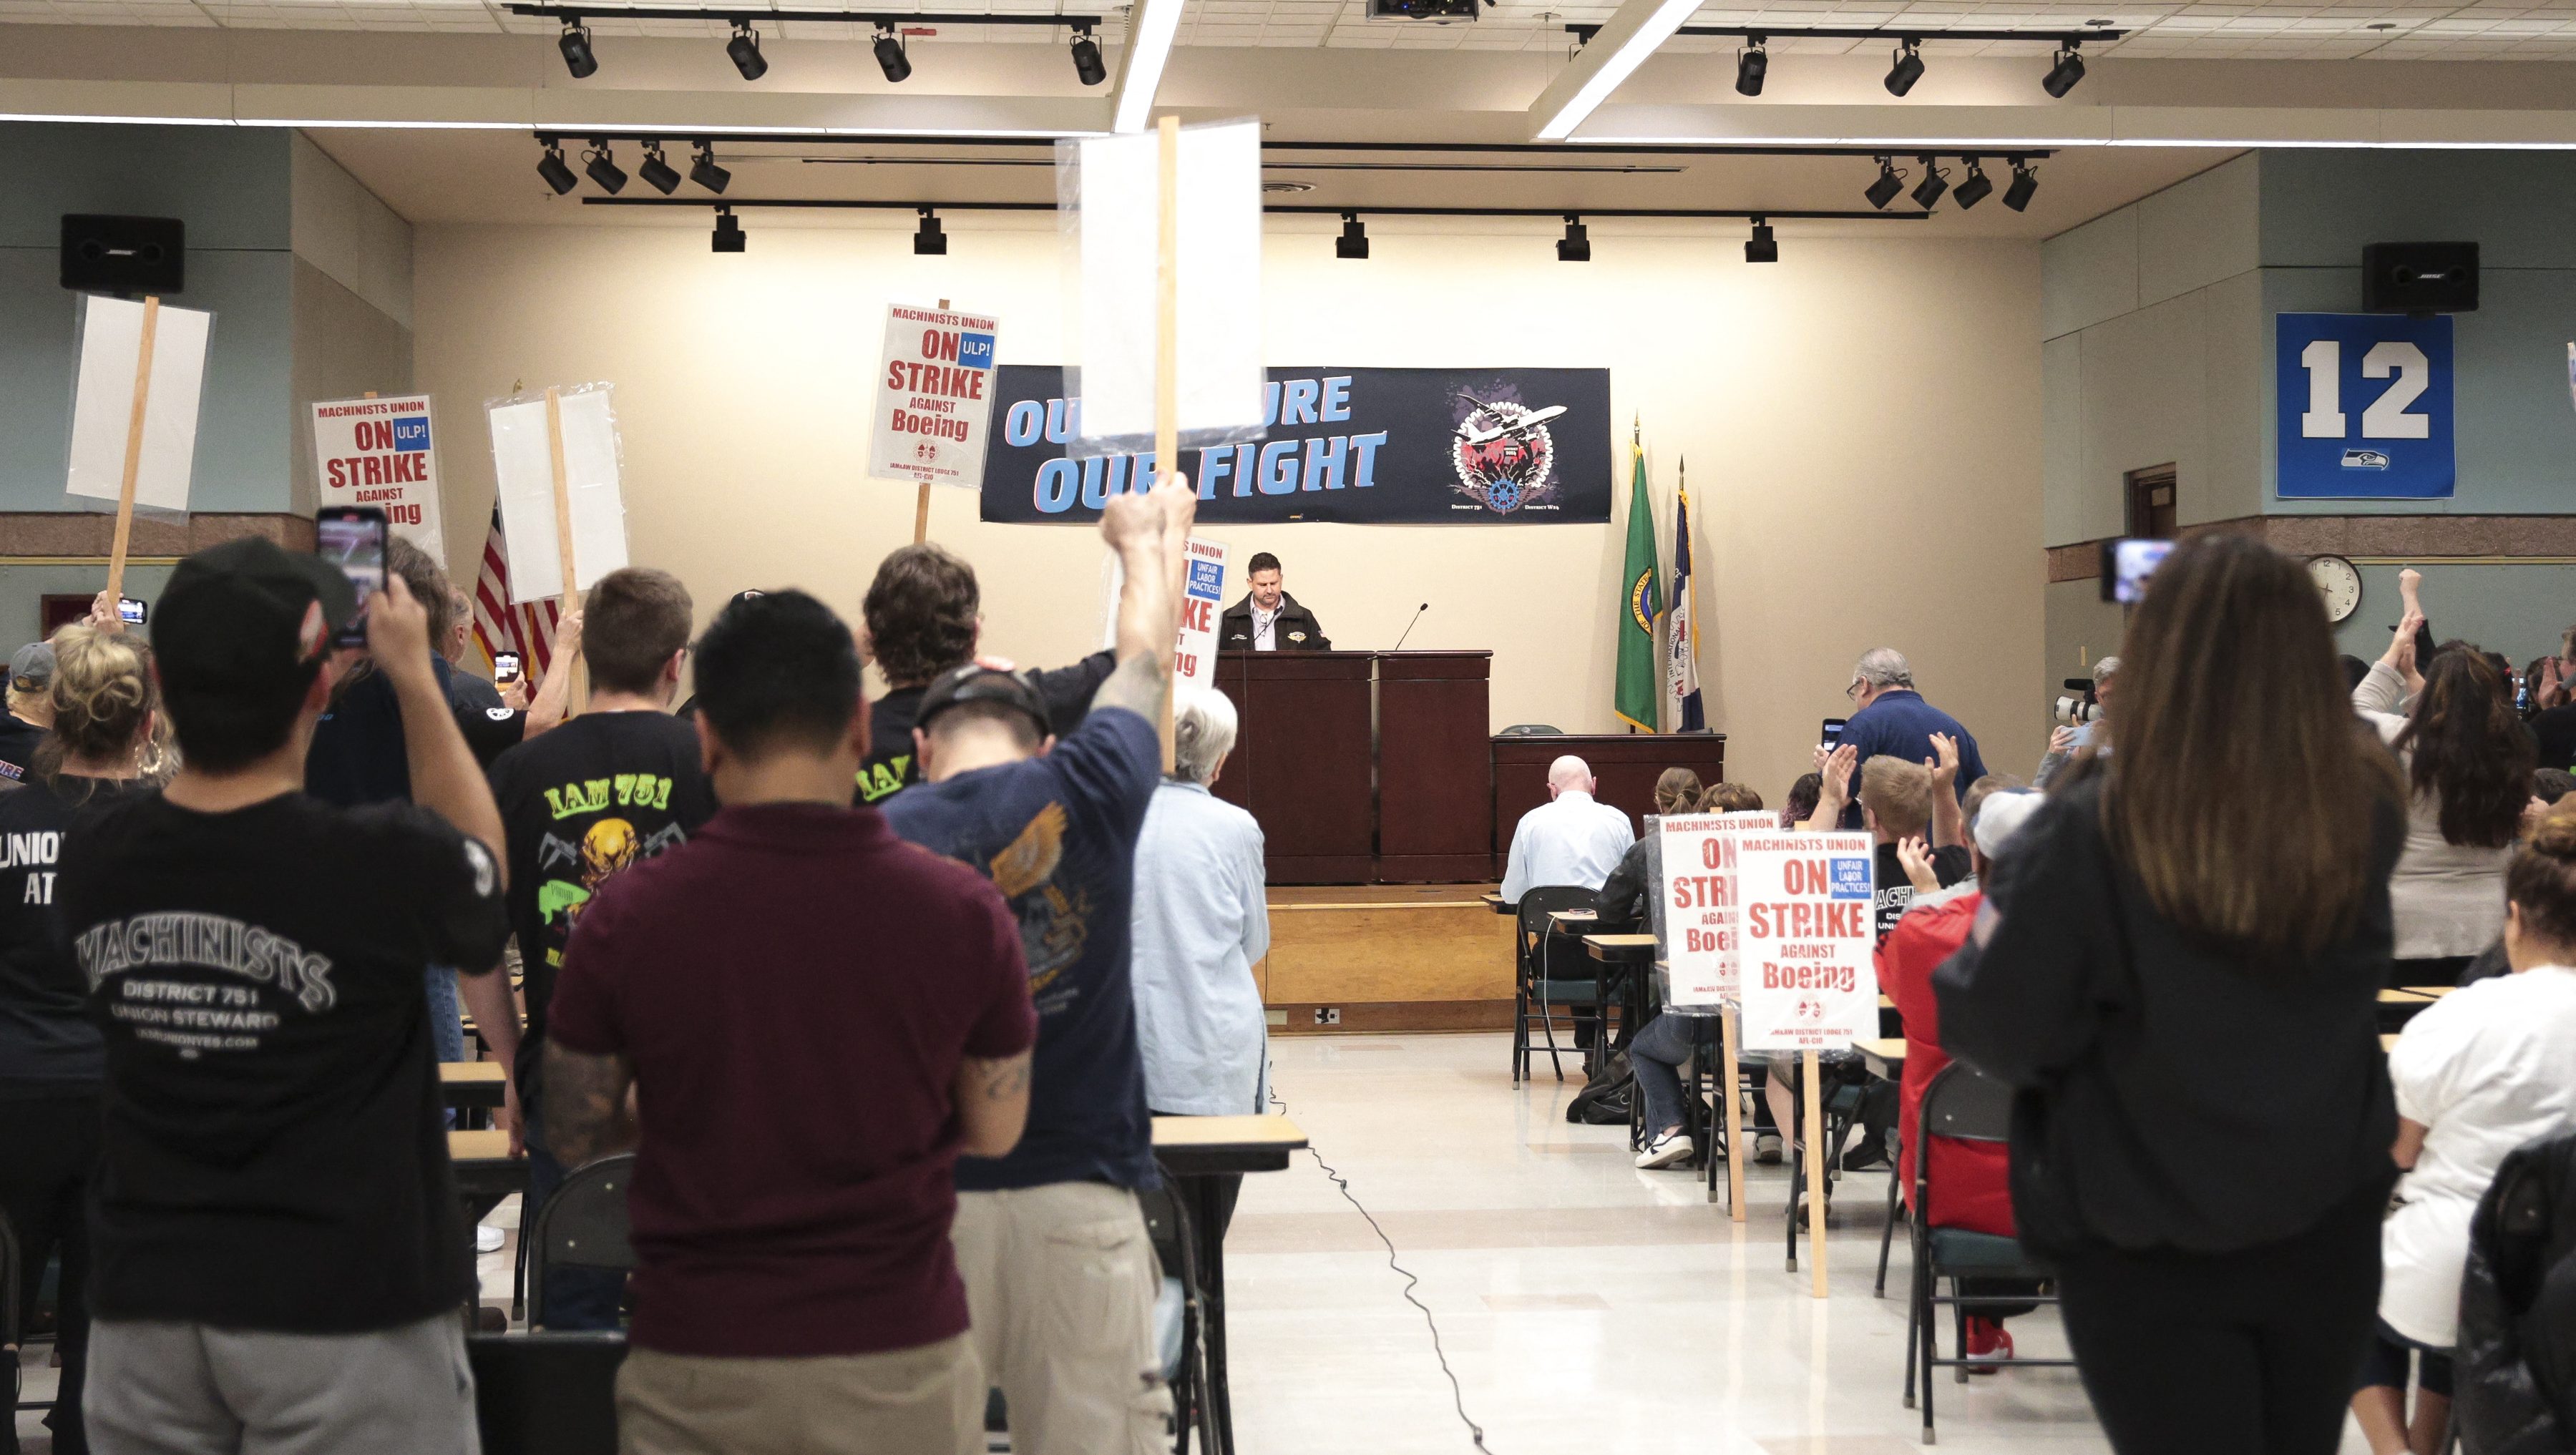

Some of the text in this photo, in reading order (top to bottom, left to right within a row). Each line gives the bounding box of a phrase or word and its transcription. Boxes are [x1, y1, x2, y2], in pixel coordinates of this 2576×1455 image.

[892, 308, 995, 330] MACHINISTS UNION
[921, 329, 960, 361] ON
[963, 341, 990, 356] ULP!
[887, 360, 985, 400] STRIKE
[2301, 340, 2429, 439] 12
[318, 401, 425, 418] MACHINISTS UNION
[909, 397, 957, 413] AGAINST
[354, 420, 393, 451] ON
[397, 425, 426, 439] ULP!
[892, 408, 969, 442] Boeing
[327, 453, 428, 488] STRIKE
[1196, 430, 1388, 501] FIGHT
[356, 488, 403, 502] AGAINST
[385, 502, 421, 525] ing
[1191, 542, 1223, 559] UNION
[1197, 562, 1218, 575] UNFAIR
[1197, 572, 1216, 584] LABOR
[1189, 580, 1221, 595] PRACTICES!
[1634, 576, 1649, 597] STATE
[544, 773, 673, 820] IAM 751
[1666, 818, 1774, 832] MACHINISTS UNION
[0, 831, 67, 868] UNIO
[1702, 837, 1737, 869] ON
[1742, 838, 1865, 851] MACHINISTS UNION
[1783, 858, 1828, 896] ON
[1837, 861, 1863, 871] UNFAIR
[1838, 871, 1863, 881] LABOR
[1673, 874, 1738, 908] STRI
[1831, 882, 1870, 893] PRACTICES!
[1702, 911, 1739, 925] AGAIN
[1749, 901, 1865, 939] STRIKE
[1687, 926, 1739, 952] Boei
[74, 909, 337, 1012] MACHINISTS
[1780, 944, 1835, 959] AGAINST
[1762, 961, 1855, 993] Boeing
[123, 979, 217, 1003] DISTRICT
[111, 1003, 280, 1029] UNION STEWARD
